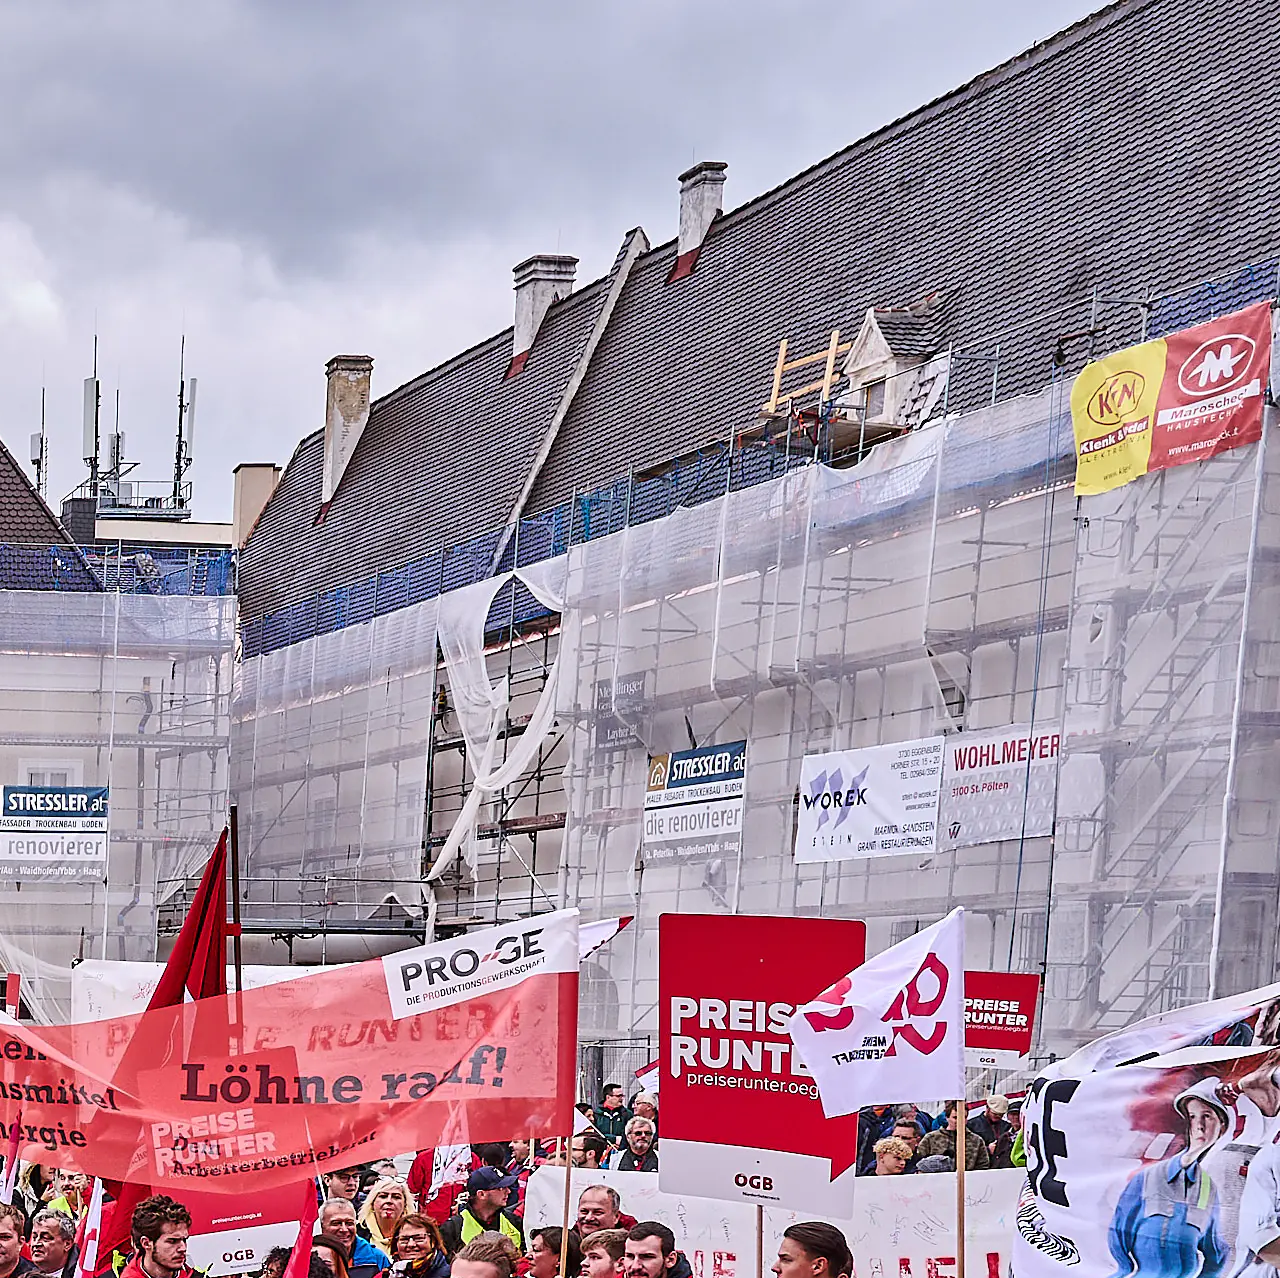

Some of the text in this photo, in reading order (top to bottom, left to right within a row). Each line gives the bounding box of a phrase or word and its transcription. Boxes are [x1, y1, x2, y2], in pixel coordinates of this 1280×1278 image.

[1170, 388, 1247, 420] Maroschec
[1080, 437, 1115, 454] Klenk
[954, 734, 1061, 771] WOHLMEYER
[803, 787, 870, 811] WOREK
[982, 781, 1009, 793] Pölten
[646, 805, 741, 836] die renovierer
[8, 836, 102, 856] renovierer
[406, 995, 421, 1007] DIE
[964, 998, 1020, 1013] PREISE
[670, 996, 800, 1035] PREIS
[964, 1011, 1028, 1026] RUNTER
[670, 1036, 811, 1079] RUNT
[180, 1062, 364, 1105] Löhne
[687, 1072, 819, 1100] preiserunter.oeg
